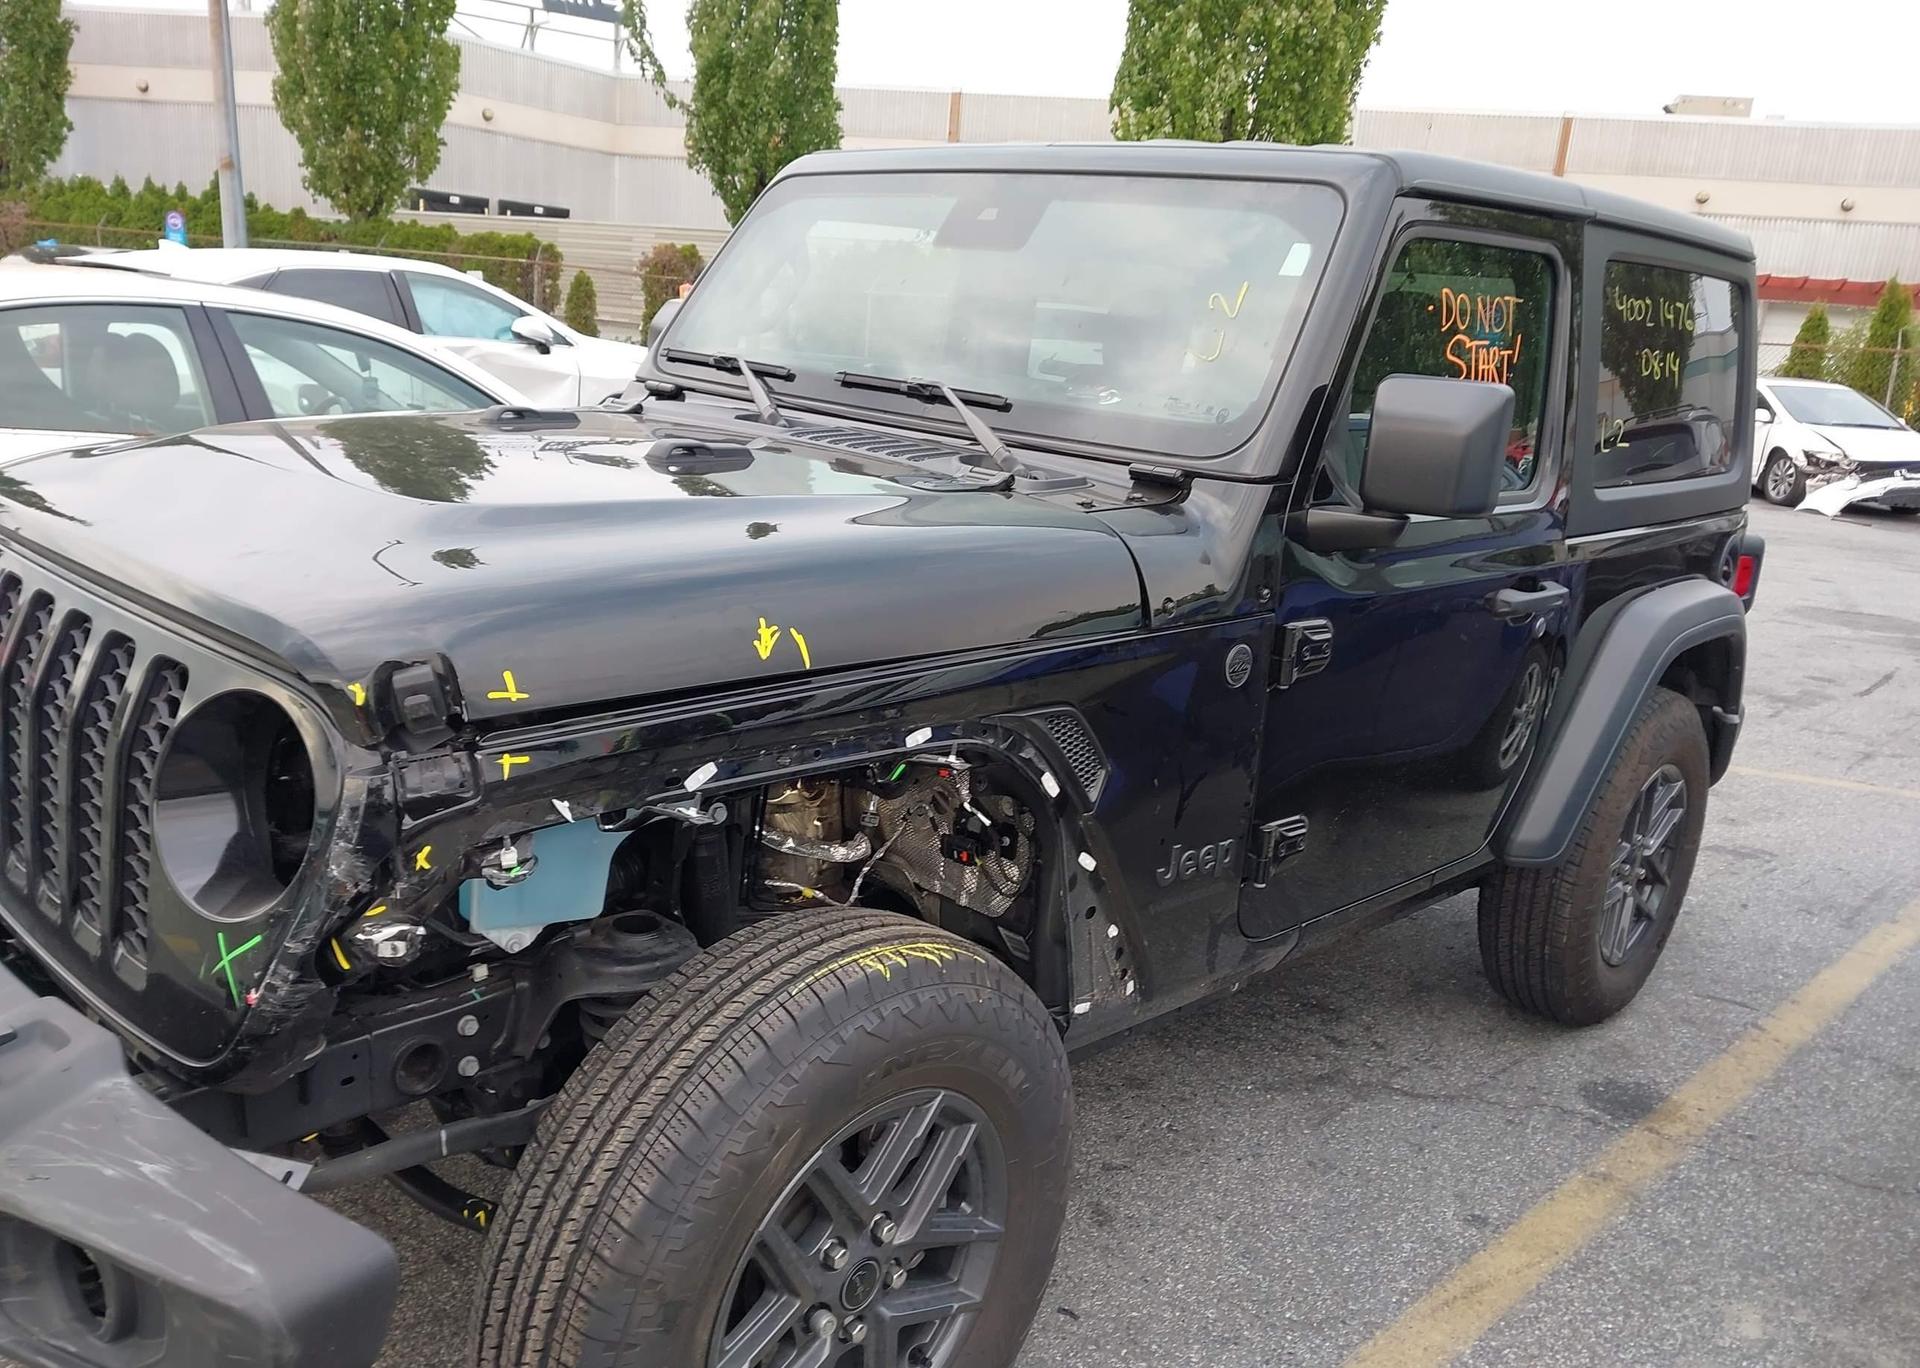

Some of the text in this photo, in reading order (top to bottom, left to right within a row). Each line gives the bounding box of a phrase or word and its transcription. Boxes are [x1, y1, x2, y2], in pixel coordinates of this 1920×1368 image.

[1441, 287, 1524, 336] DO NOT
[1155, 838, 1236, 887] Jeep
